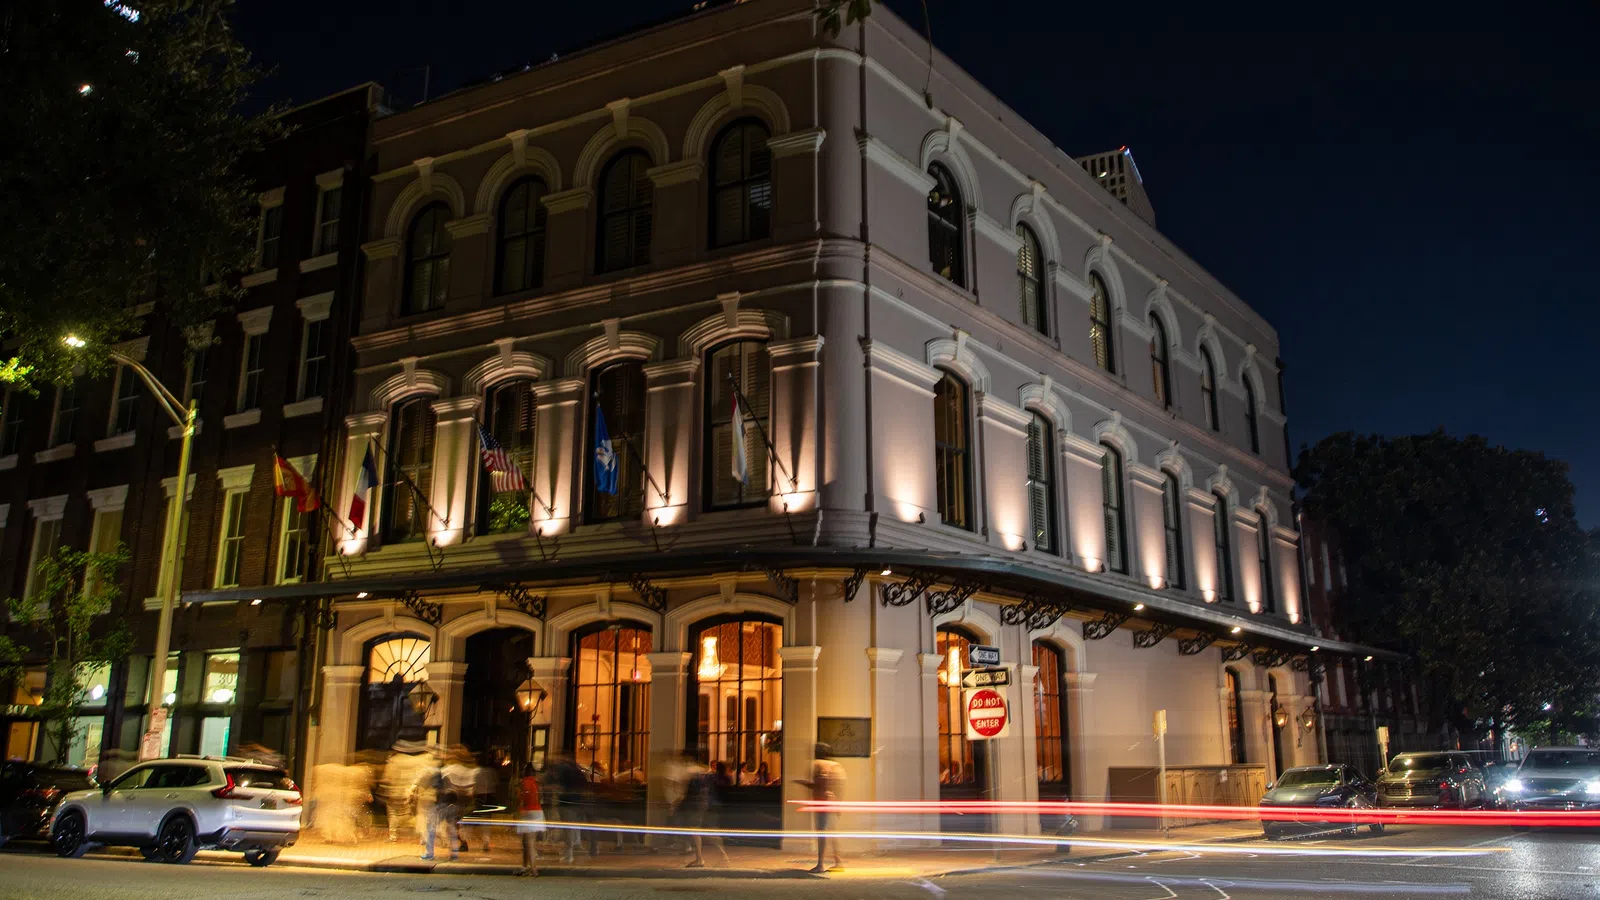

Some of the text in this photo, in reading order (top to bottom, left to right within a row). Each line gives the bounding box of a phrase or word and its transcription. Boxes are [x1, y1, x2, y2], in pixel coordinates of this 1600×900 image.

[979, 650, 997, 660] ONE WAY
[975, 674, 988, 682] ONE
[972, 697, 1001, 707] DO NOT
[976, 718, 1000, 729] ENTER
